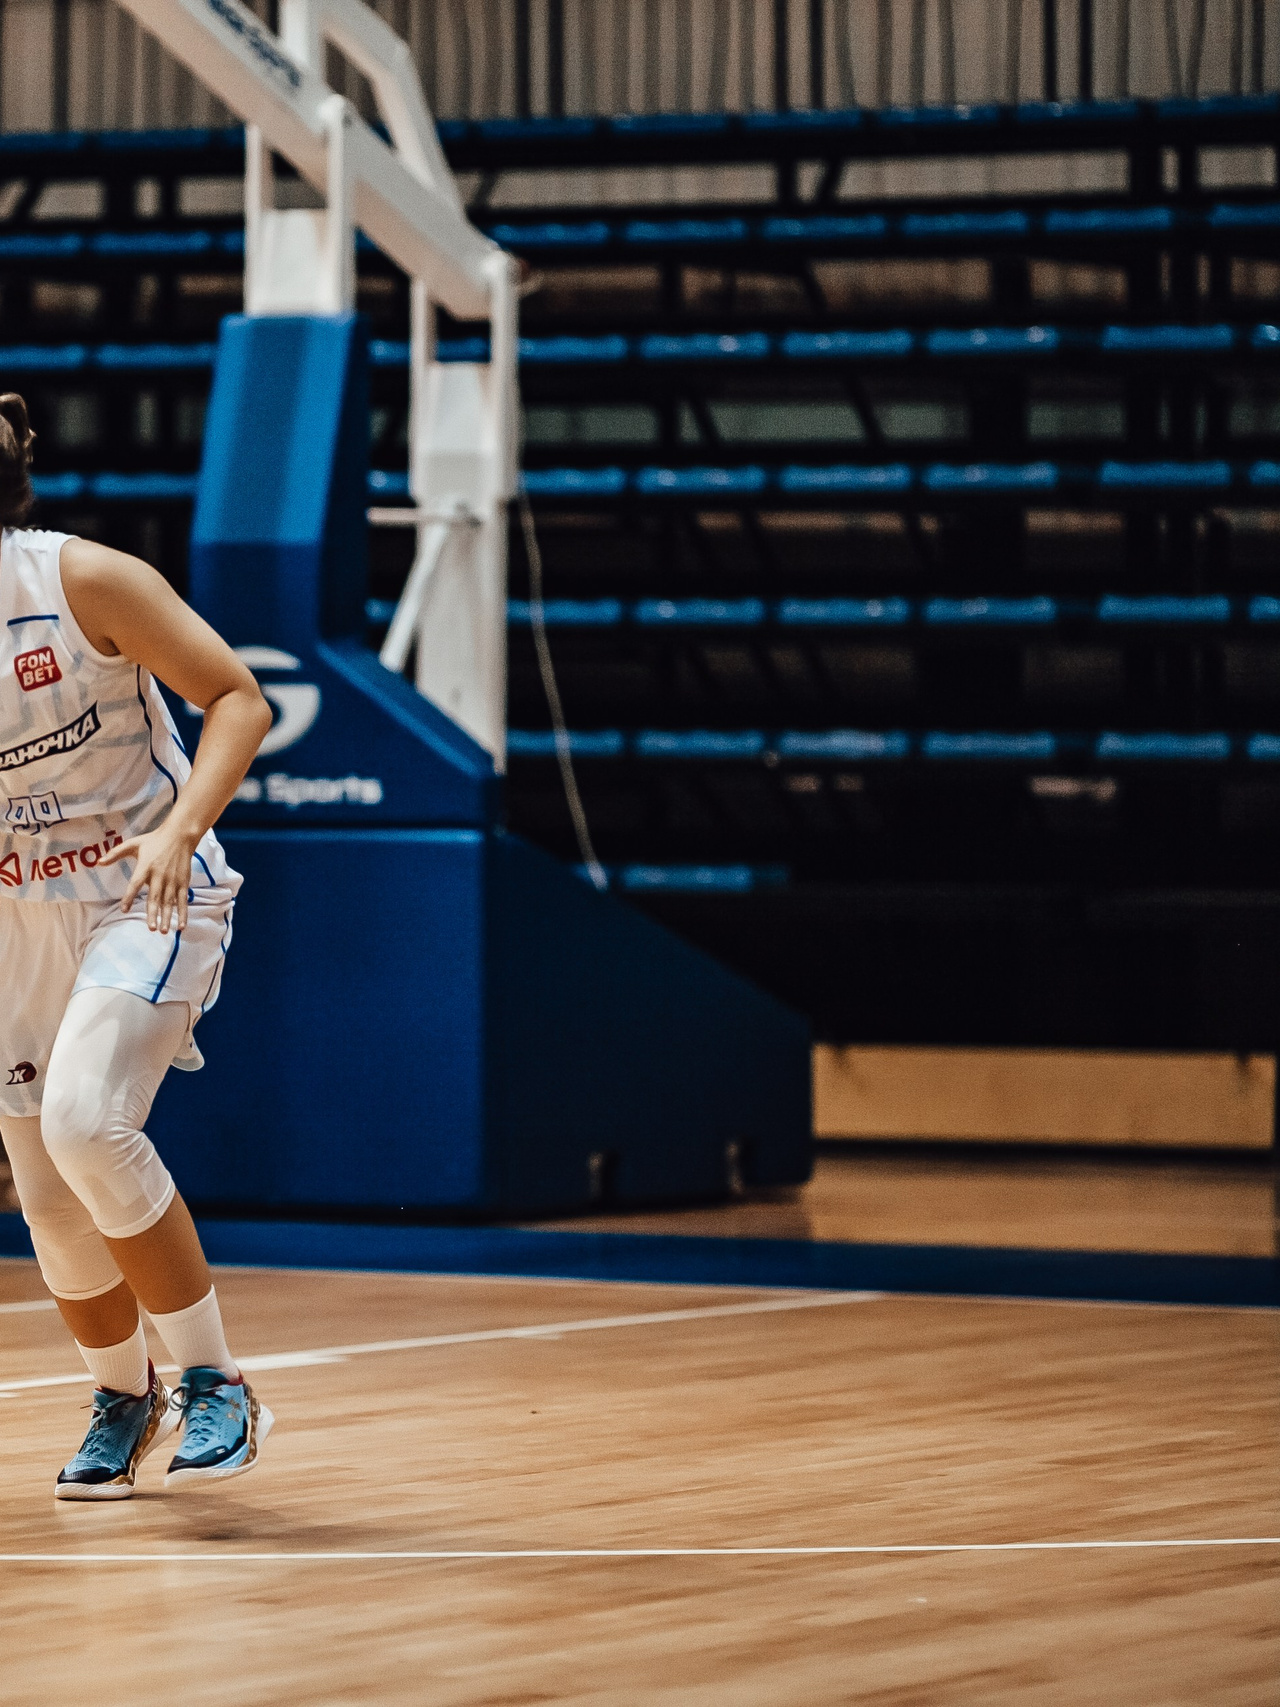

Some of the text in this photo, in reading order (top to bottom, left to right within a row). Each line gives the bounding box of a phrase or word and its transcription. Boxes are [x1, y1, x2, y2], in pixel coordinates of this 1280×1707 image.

[18, 651, 51, 673] FON
[23, 665, 55, 688] BET
[266, 773, 382, 808] Sports
